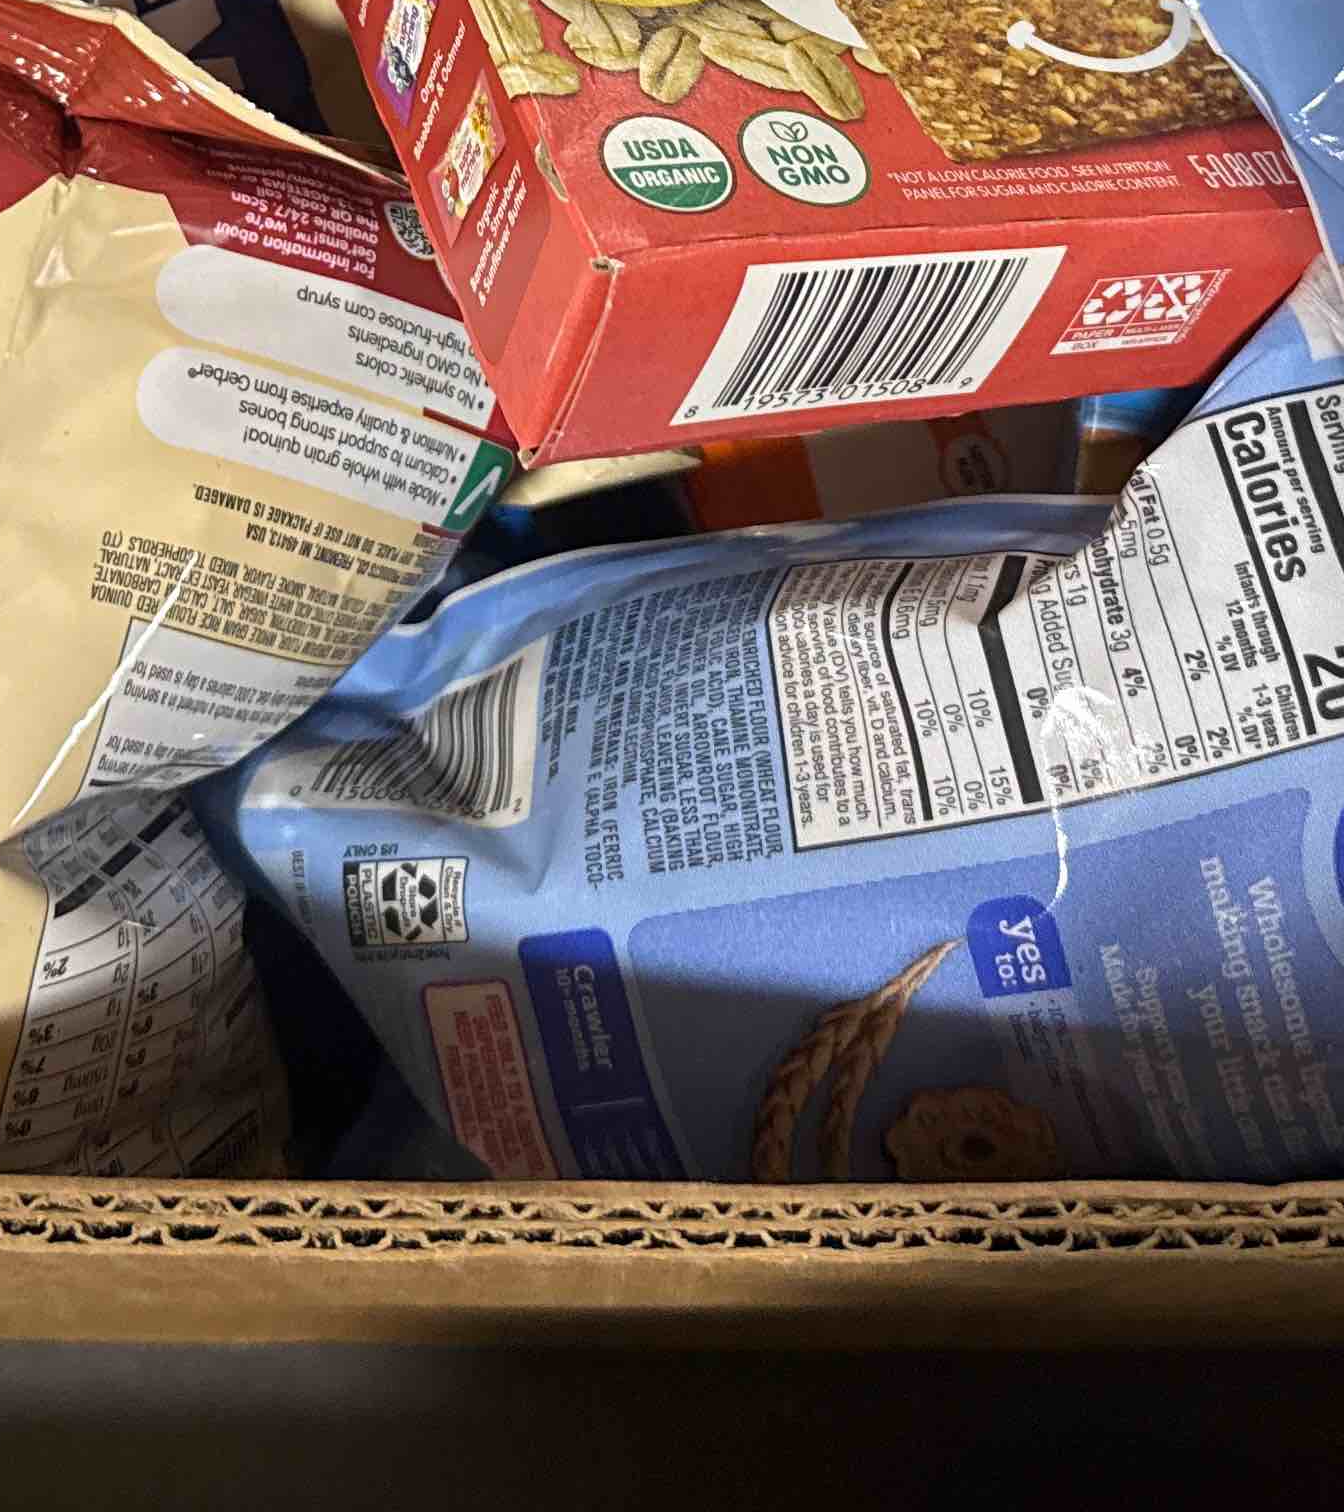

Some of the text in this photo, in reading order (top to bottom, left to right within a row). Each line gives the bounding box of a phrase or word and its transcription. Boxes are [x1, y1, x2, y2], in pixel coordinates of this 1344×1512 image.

[419, 47, 444, 105] Organic
[444, 19, 467, 84] Oatmeal
[623, 136, 701, 162] USDA
[765, 141, 837, 166] NON
[938, 168, 975, 182] LOW
[974, 167, 1027, 181] CALORIE
[1072, 164, 1099, 177] SEE
[491, 160, 521, 236] Strawberry
[630, 162, 720, 190] ORGANIC
[777, 161, 853, 189] GMO
[904, 187, 950, 201] PANEL
[949, 186, 975, 199] FOR
[974, 184, 1030, 199] SUGAR
[1030, 183, 1060, 196] AND
[1060, 179, 1117, 195] CALORIE
[475, 180, 500, 237] Organic
[214, 222, 374, 278] For information about
[483, 182, 529, 295] Sunflower Butter
[346, 324, 482, 383] No GMO ingredients
[252, 379, 287, 403] from
[354, 353, 475, 406] No synthetic colors
[744, 379, 927, 413] 19573 01508
[289, 389, 353, 425] expertise
[354, 408, 398, 438] quality
[238, 399, 449, 482] Calcium to support strong bones
[399, 428, 409, 442] &
[410, 432, 458, 460] Nutrition
[242, 425, 439, 504] Made with whole grain quinoa!
[191, 484, 311, 530] PACKAGE IS DAMAGED.
[1223, 409, 1314, 584] Calories
[748, 701, 766, 744] FLOUR
[754, 751, 774, 802] (WHEAT
[343, 843, 399, 857] US ONLY
[346, 875, 362, 934] POUCH
[361, 868, 377, 938] PLASTIC
[994, 914, 1047, 985] yes
[572, 963, 616, 1071] Crawler
